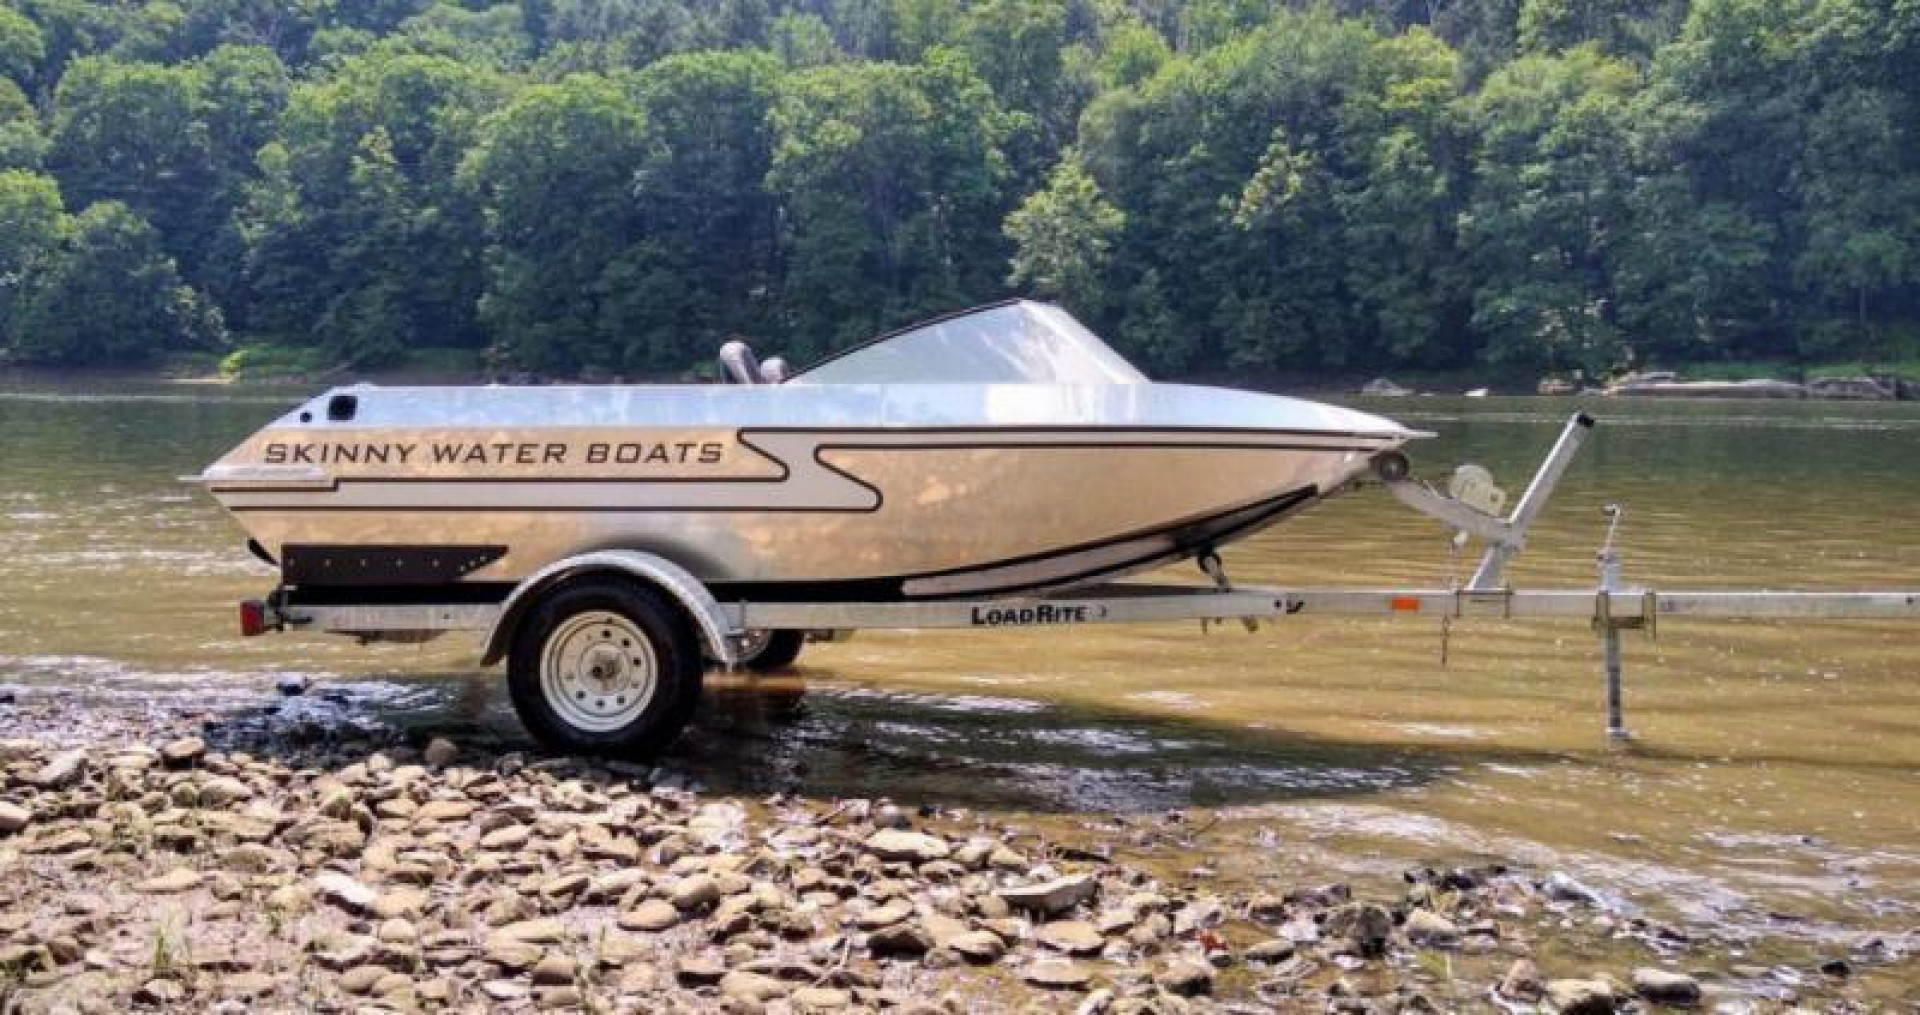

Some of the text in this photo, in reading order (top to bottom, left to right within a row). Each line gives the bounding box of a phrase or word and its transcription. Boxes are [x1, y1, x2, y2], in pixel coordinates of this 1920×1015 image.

[264, 442, 724, 464] SKINNY WATER BOATS
